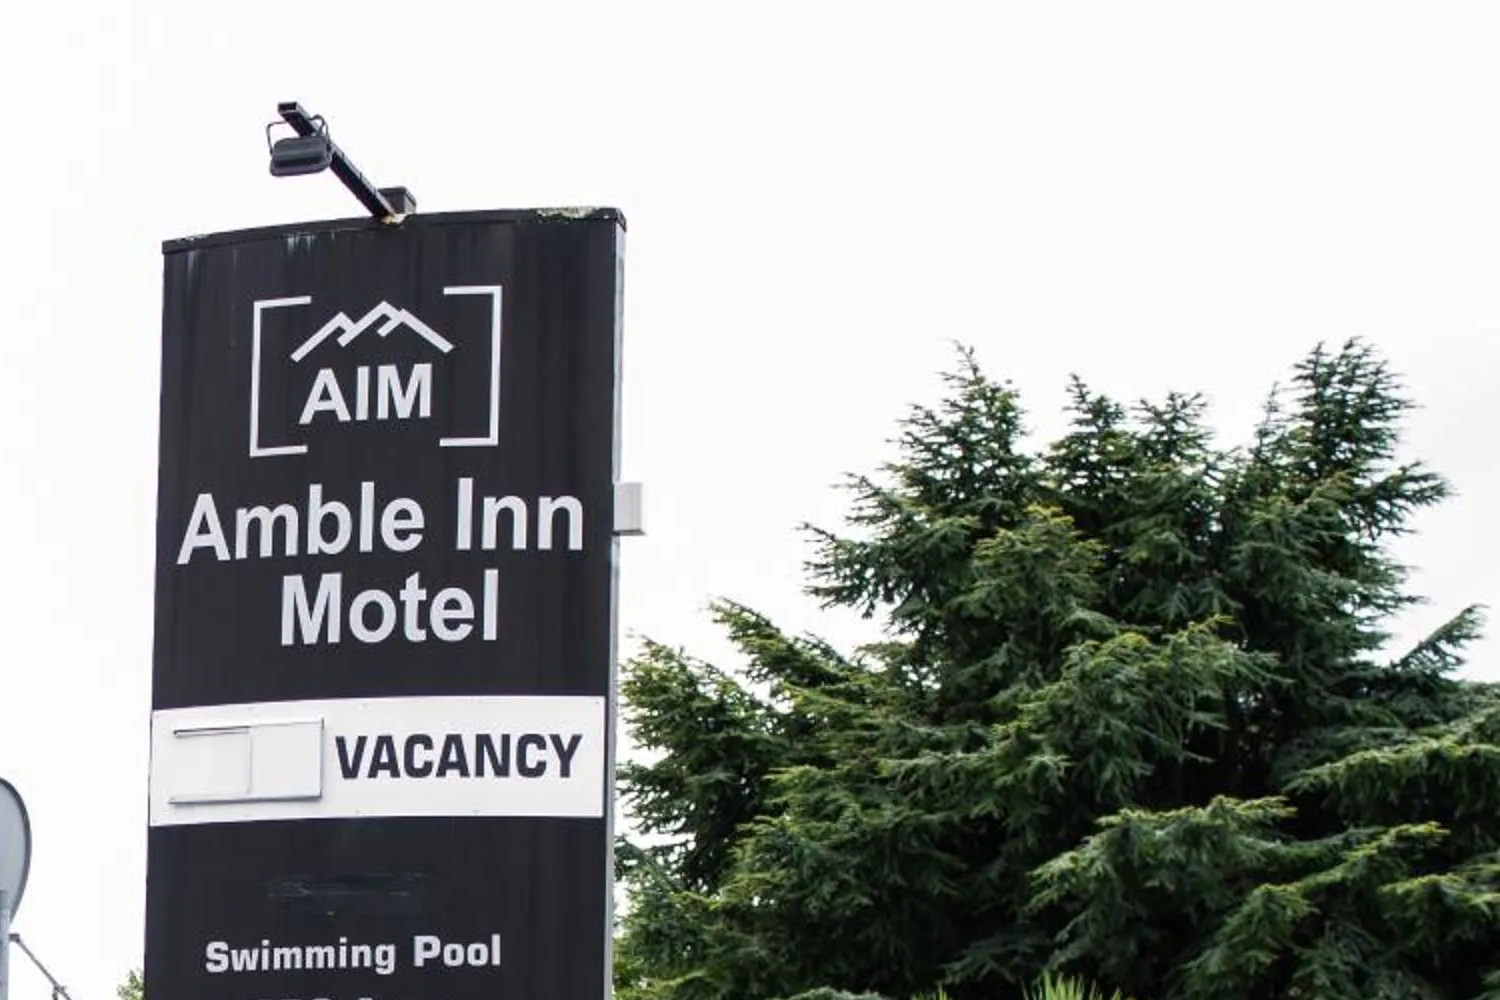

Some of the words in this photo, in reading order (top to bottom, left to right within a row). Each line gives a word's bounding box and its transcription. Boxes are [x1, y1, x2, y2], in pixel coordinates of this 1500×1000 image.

[299, 363, 432, 425] AIM
[176, 480, 425, 565] Amble
[455, 477, 584, 551] Inn
[281, 568, 499, 646] Motel
[334, 733, 583, 779] VACANCY
[205, 937, 396, 975] Swimming
[413, 934, 501, 967] Pool
